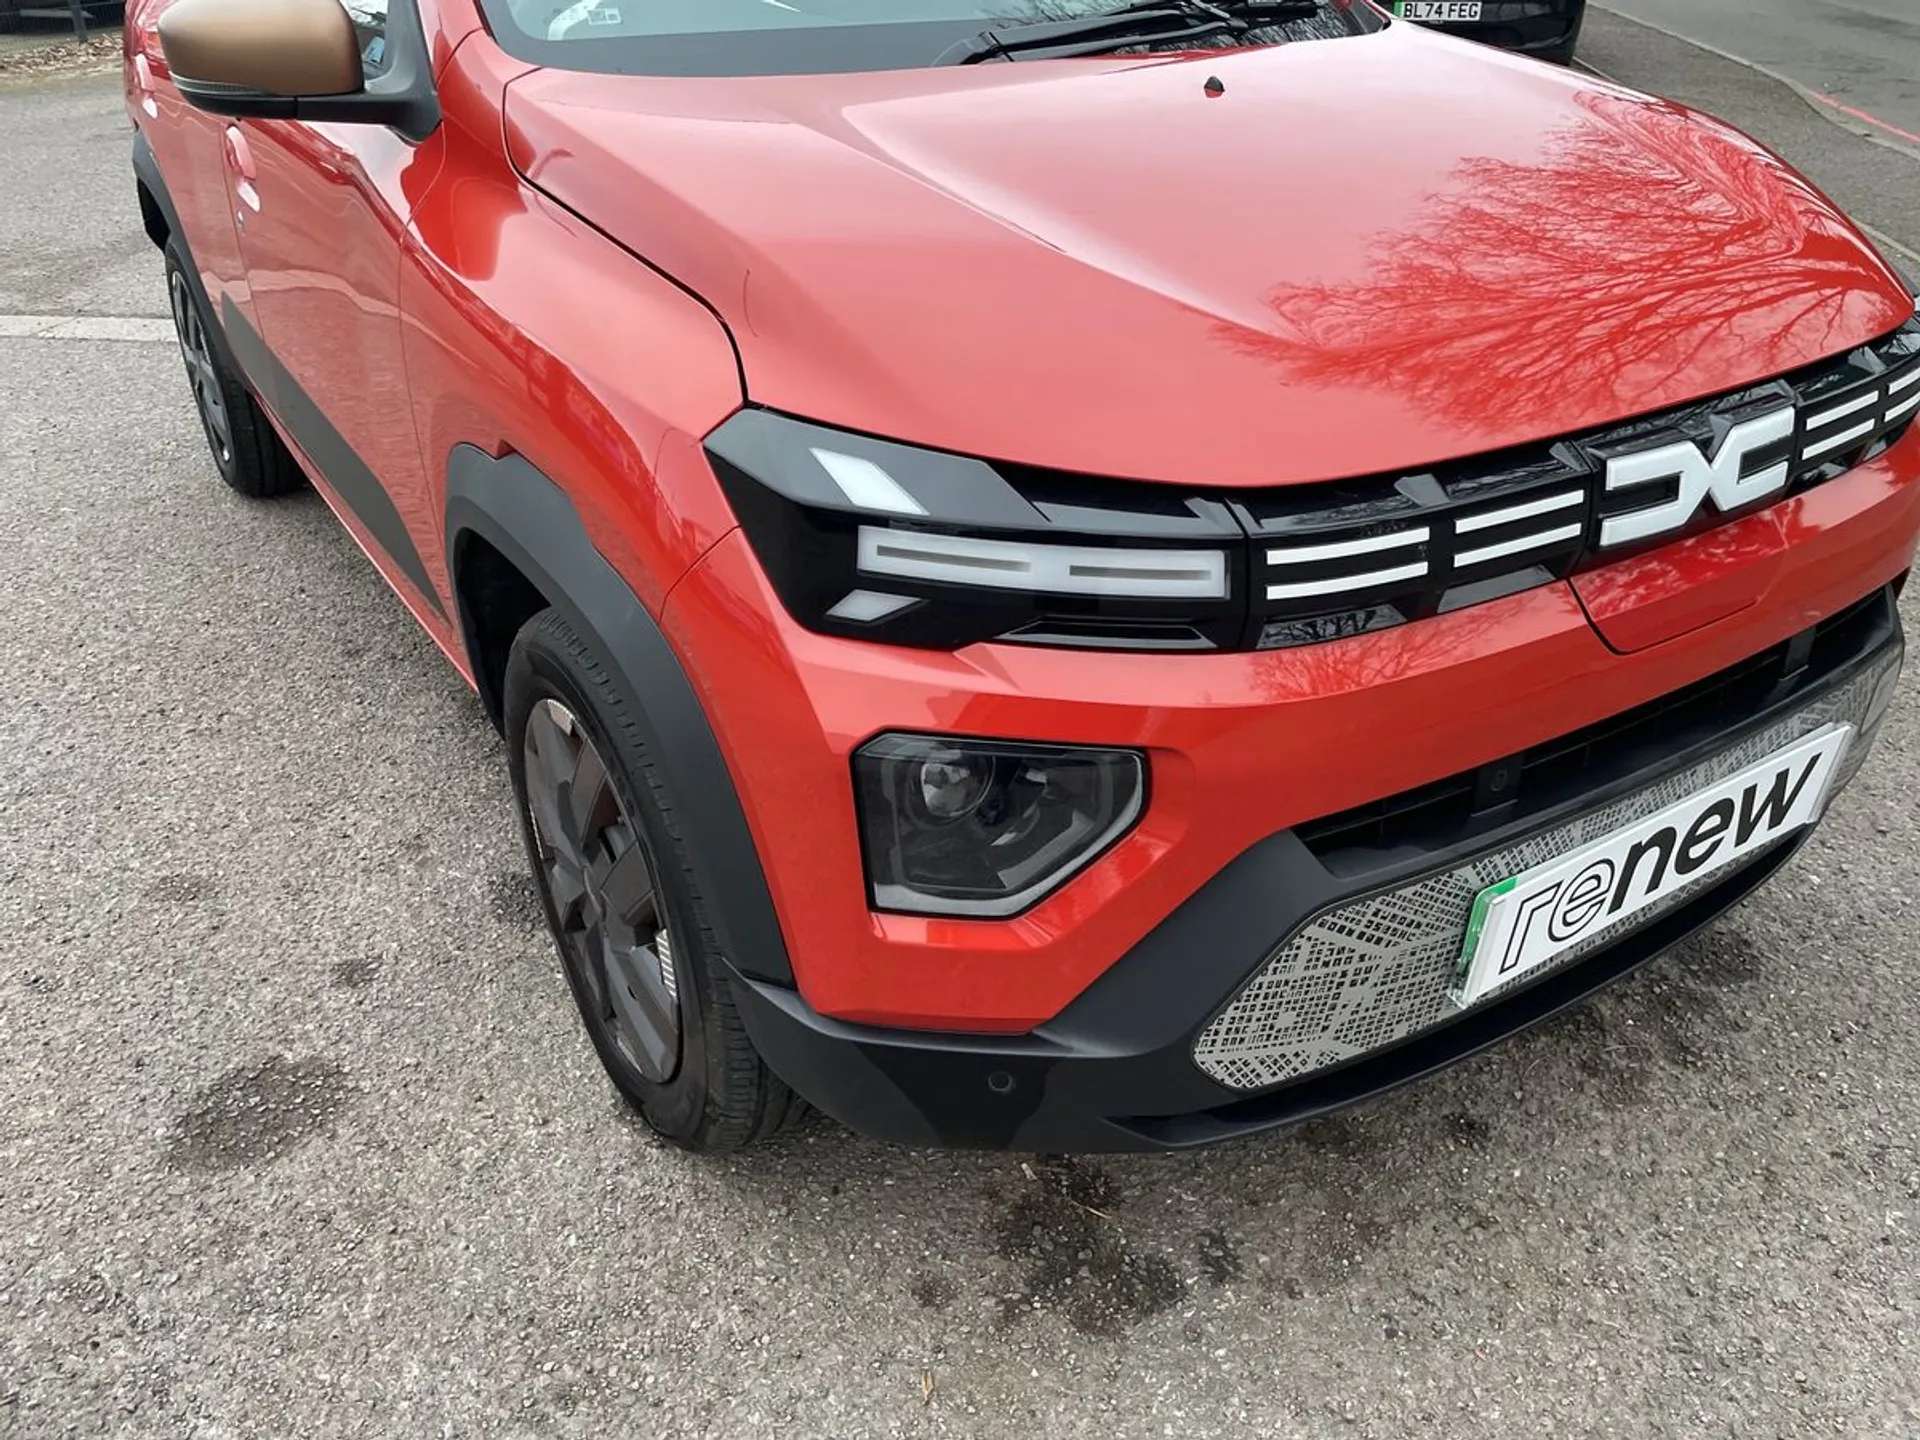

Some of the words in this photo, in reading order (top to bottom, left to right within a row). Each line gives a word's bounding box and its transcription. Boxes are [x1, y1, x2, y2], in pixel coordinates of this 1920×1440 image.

[1404, 3, 1443, 17] BL74
[1448, 3, 1478, 17] FEG
[1500, 752, 1822, 975] renew
